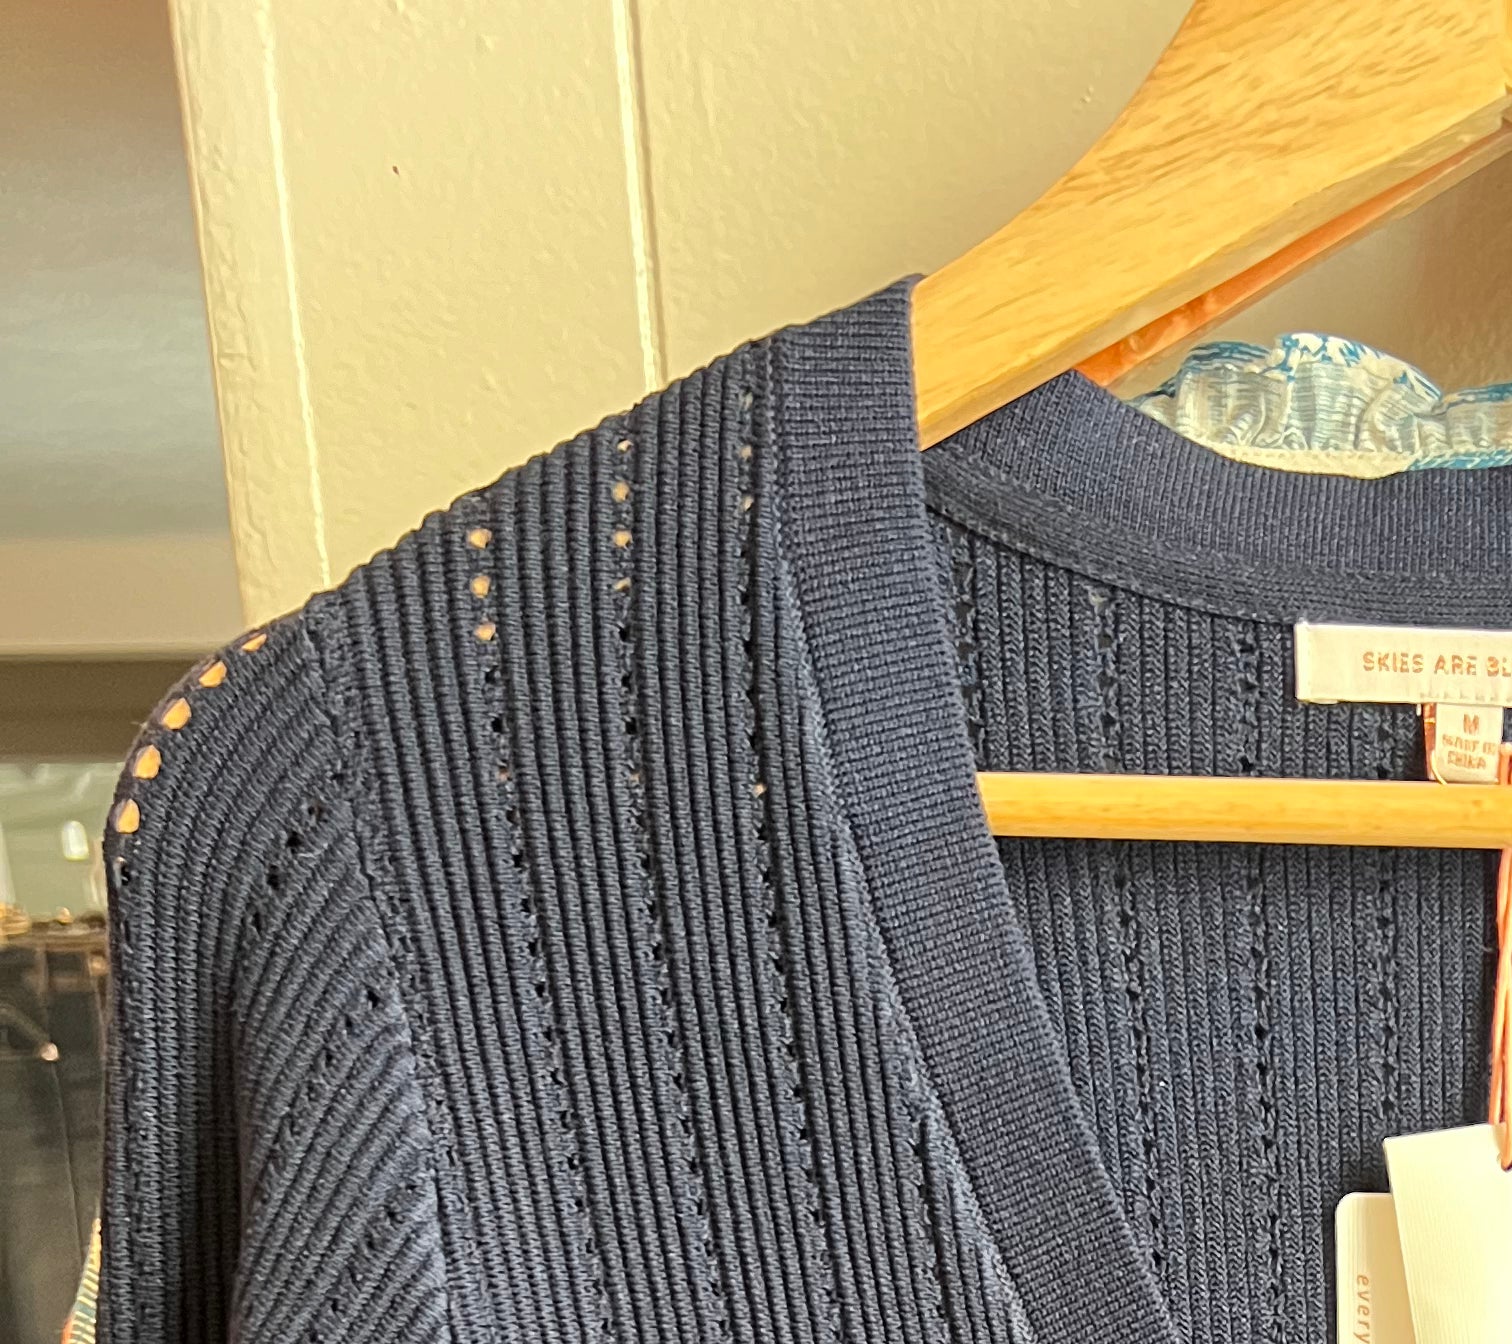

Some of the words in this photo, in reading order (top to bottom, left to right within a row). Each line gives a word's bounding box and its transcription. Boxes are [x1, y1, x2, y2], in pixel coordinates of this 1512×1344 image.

[1362, 651, 1424, 674] SKIES
[1433, 654, 1478, 676] ARE
[1463, 713, 1480, 735] M
